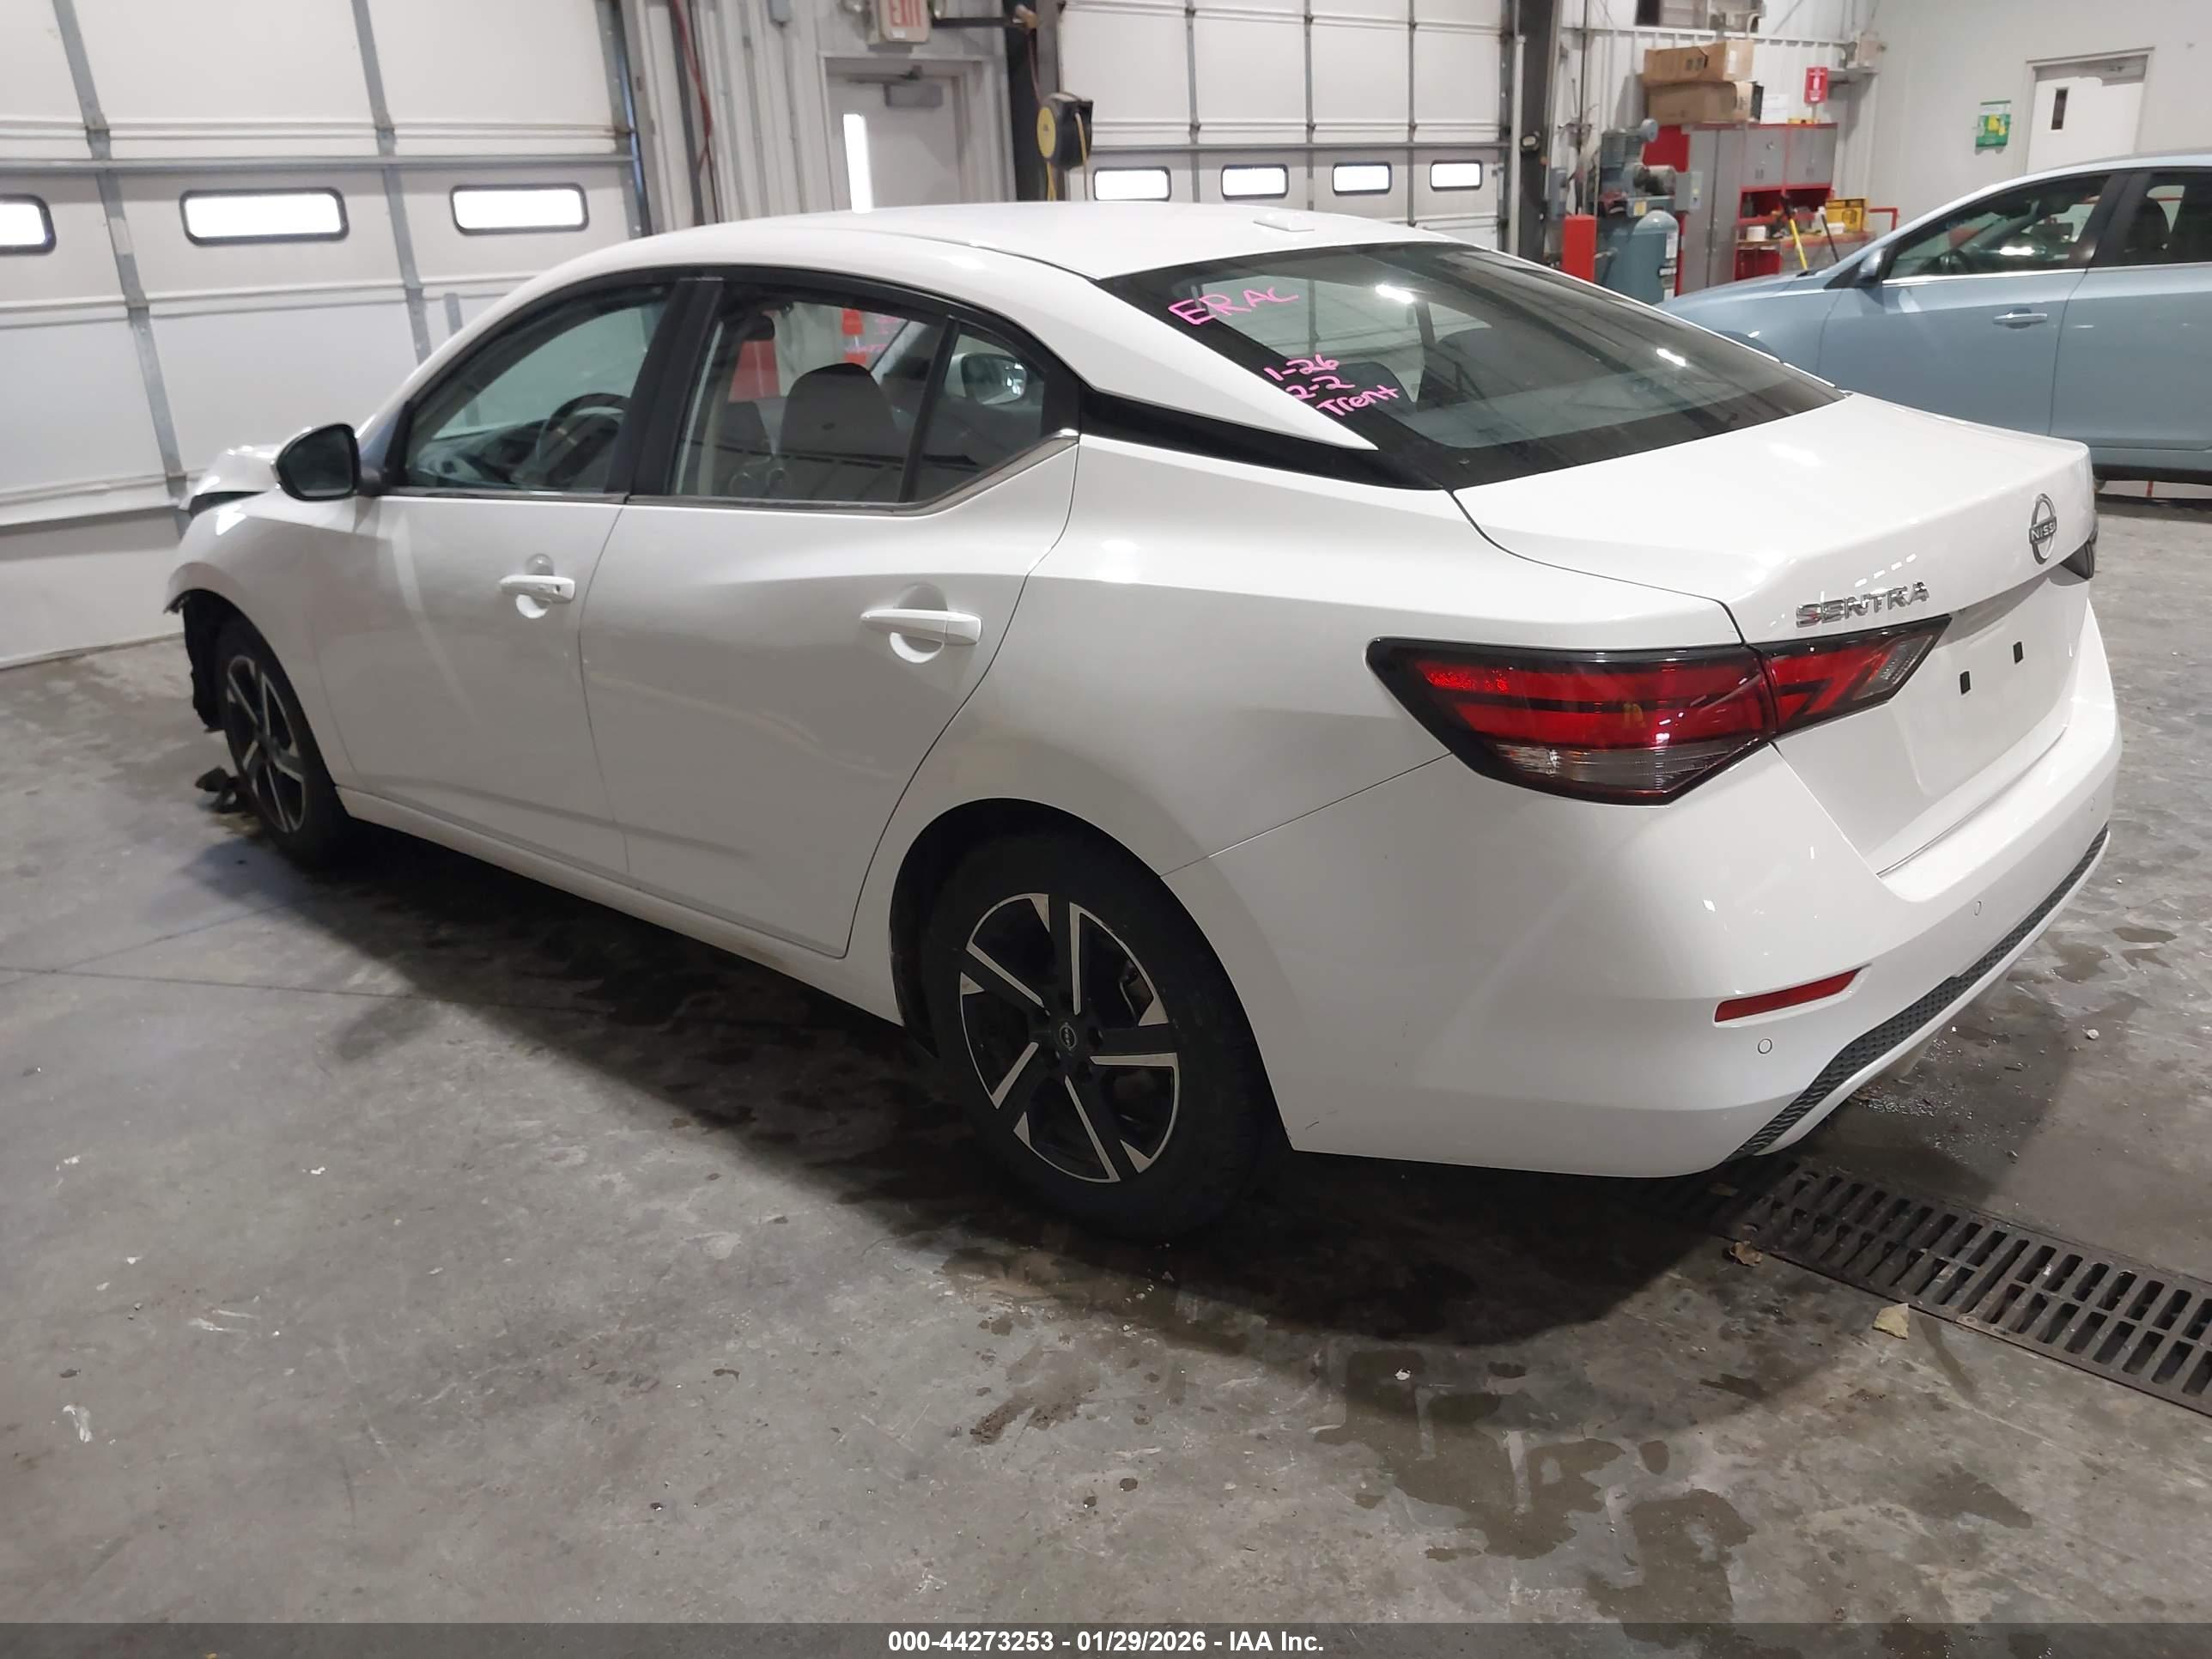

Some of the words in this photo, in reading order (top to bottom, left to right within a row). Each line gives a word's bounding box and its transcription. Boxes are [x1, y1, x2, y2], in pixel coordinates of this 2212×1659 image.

[888, 0, 921, 27] EXIT
[1168, 287, 1299, 325] ERAC
[1263, 354, 1340, 381] 1-26
[1285, 374, 1356, 400] 2-2
[1316, 384, 1400, 416] Trent
[1796, 580, 1930, 629] SENTRA
